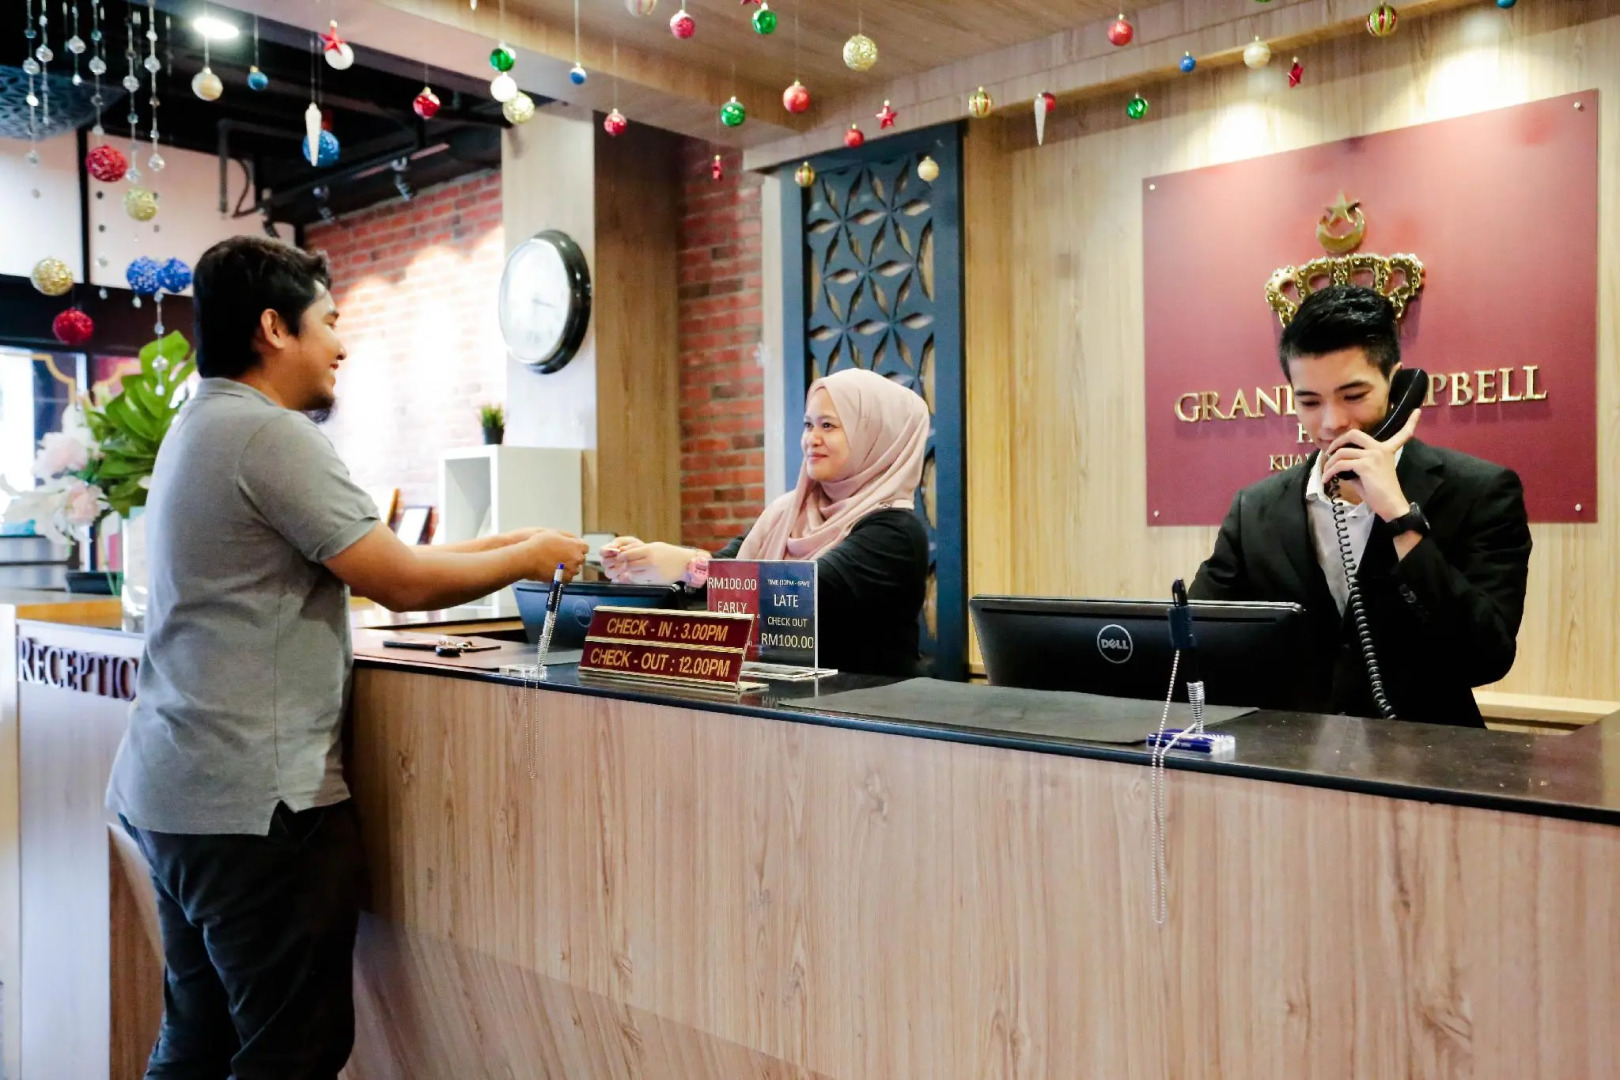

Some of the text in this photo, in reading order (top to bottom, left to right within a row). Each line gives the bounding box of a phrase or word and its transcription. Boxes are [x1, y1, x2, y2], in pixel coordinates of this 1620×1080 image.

[1422, 364, 1548, 407] PBELL
[1268, 453, 1311, 471] KUA
[708, 577, 757, 591] RM100.00
[717, 601, 748, 614] EARLY
[773, 593, 799, 608] LATE
[606, 618, 649, 636] CHECK
[657, 620, 673, 638] IN
[680, 622, 729, 642] 3.00PM
[767, 616, 808, 628] CHECK OUT
[761, 632, 814, 649] RM100.00
[1100, 638, 1129, 650] DELL
[18, 636, 139, 701] RECEPTIO
[590, 647, 633, 667] CHECK
[641, 652, 669, 671] OUT
[678, 656, 731, 677] 12.00PM
